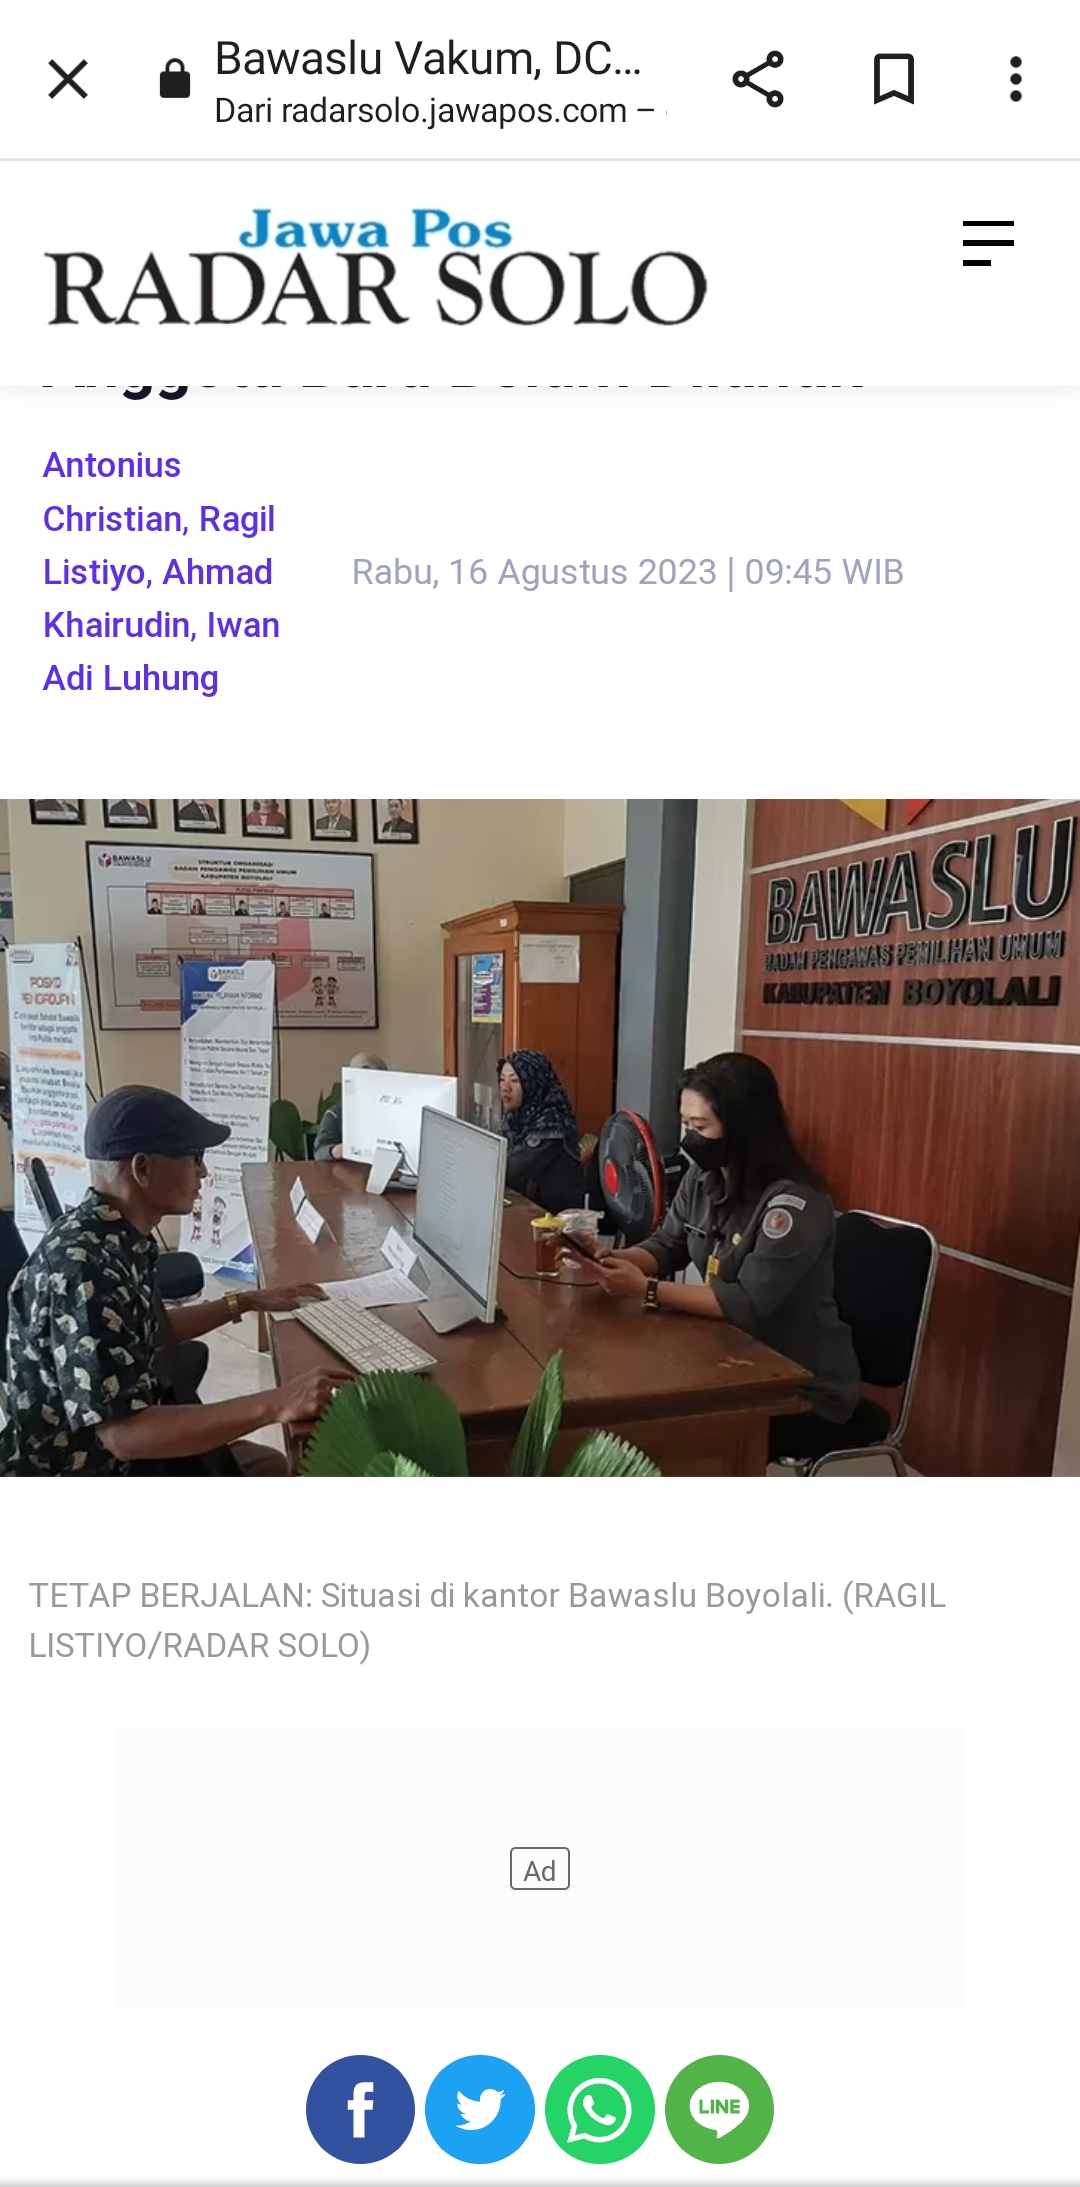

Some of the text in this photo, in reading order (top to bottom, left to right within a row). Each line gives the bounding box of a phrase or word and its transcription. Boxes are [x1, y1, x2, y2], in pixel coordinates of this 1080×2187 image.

[765, 816, 1075, 946] BAWASLU
[764, 930, 1065, 971] BADAN PENGAWAS PEMILIHAN UMUM
[762, 975, 1062, 1006] KABUPATEN BOYOLALI
